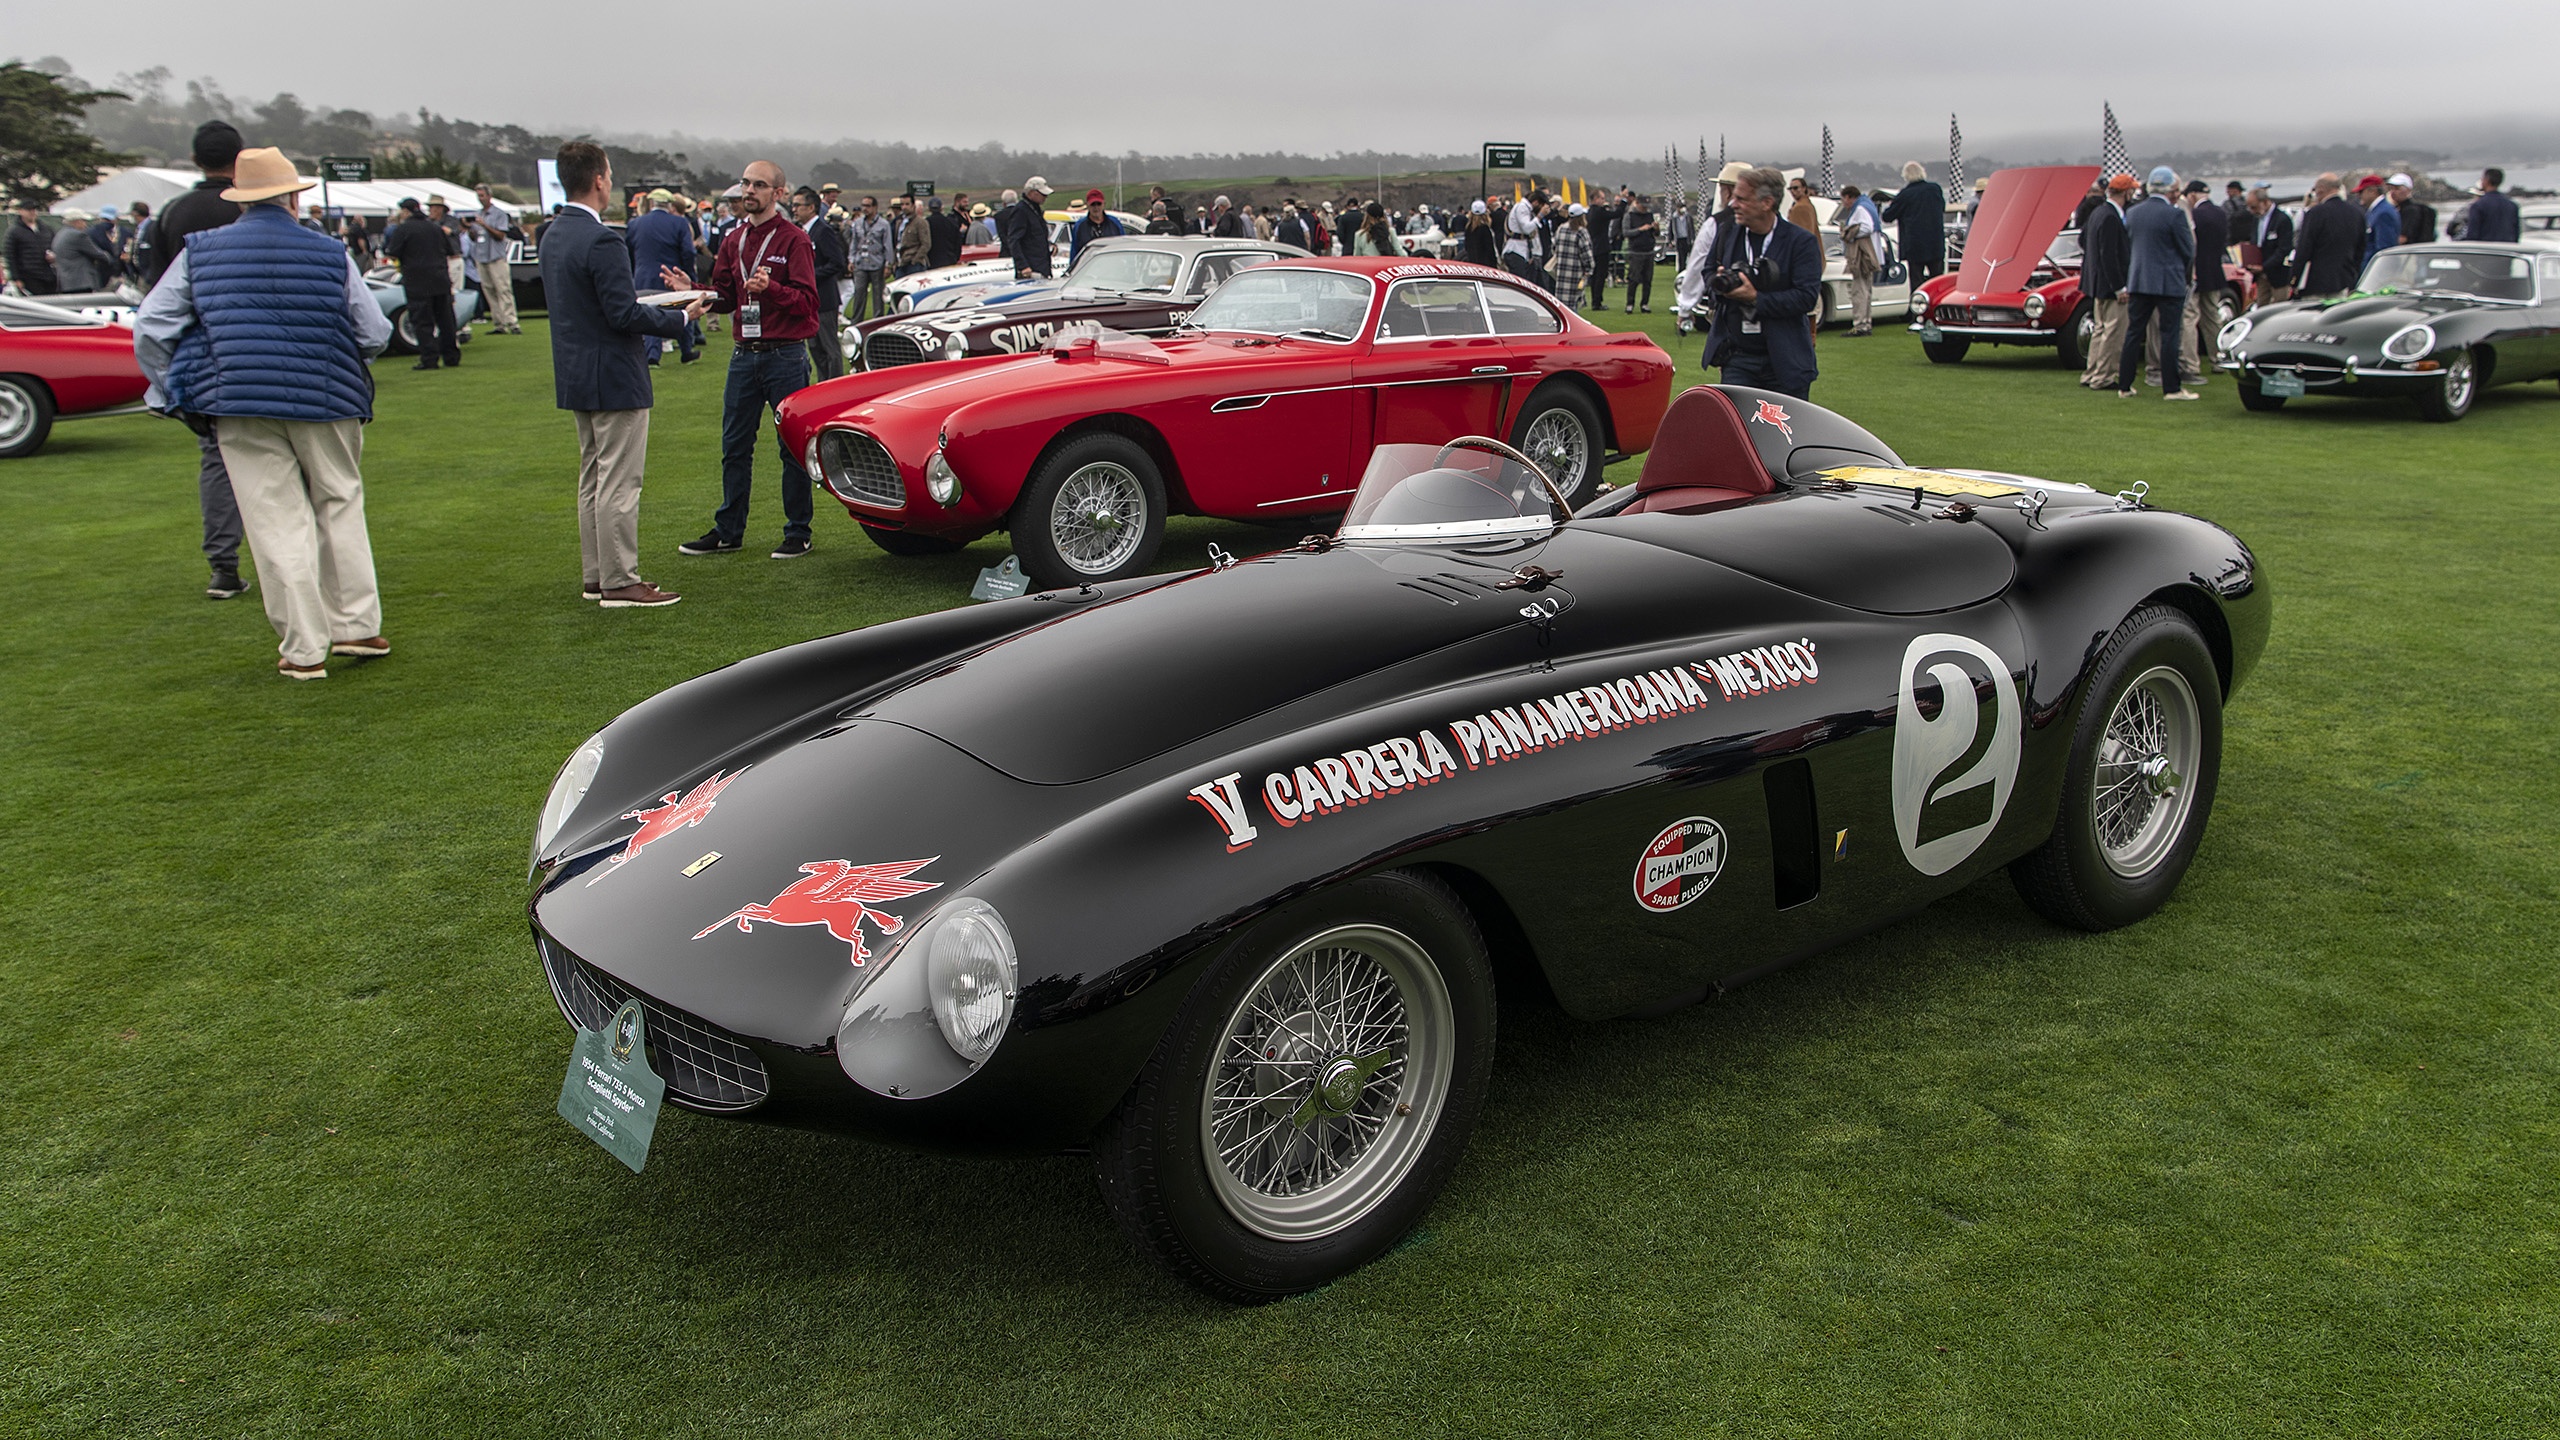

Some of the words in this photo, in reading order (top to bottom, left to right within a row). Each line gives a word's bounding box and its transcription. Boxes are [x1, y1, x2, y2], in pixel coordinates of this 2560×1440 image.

[1387, 264, 1439, 278] CARRERA
[1436, 264, 1517, 284] PANAMERICANA
[1517, 277, 1562, 308] MEXICO
[1187, 772, 1258, 854] V
[1263, 730, 1459, 828] CARRERA
[1449, 666, 1708, 772] PANAMERICANA
[1652, 823, 1693, 855] EQUIPPED
[1694, 823, 1714, 837] WITH
[1648, 846, 1714, 883] CHAMPION
[1651, 893, 1680, 906] SPARK
[1681, 875, 1709, 902] PLUGS
[582, 1056, 595, 1072] 1954
[594, 1065, 613, 1085] Ferrari
[612, 1077, 623, 1091] 735
[622, 1084, 628, 1095] S
[627, 1087, 646, 1108] Monza
[587, 1075, 613, 1100] Scaglietti
[597, 1122, 615, 1140] California
